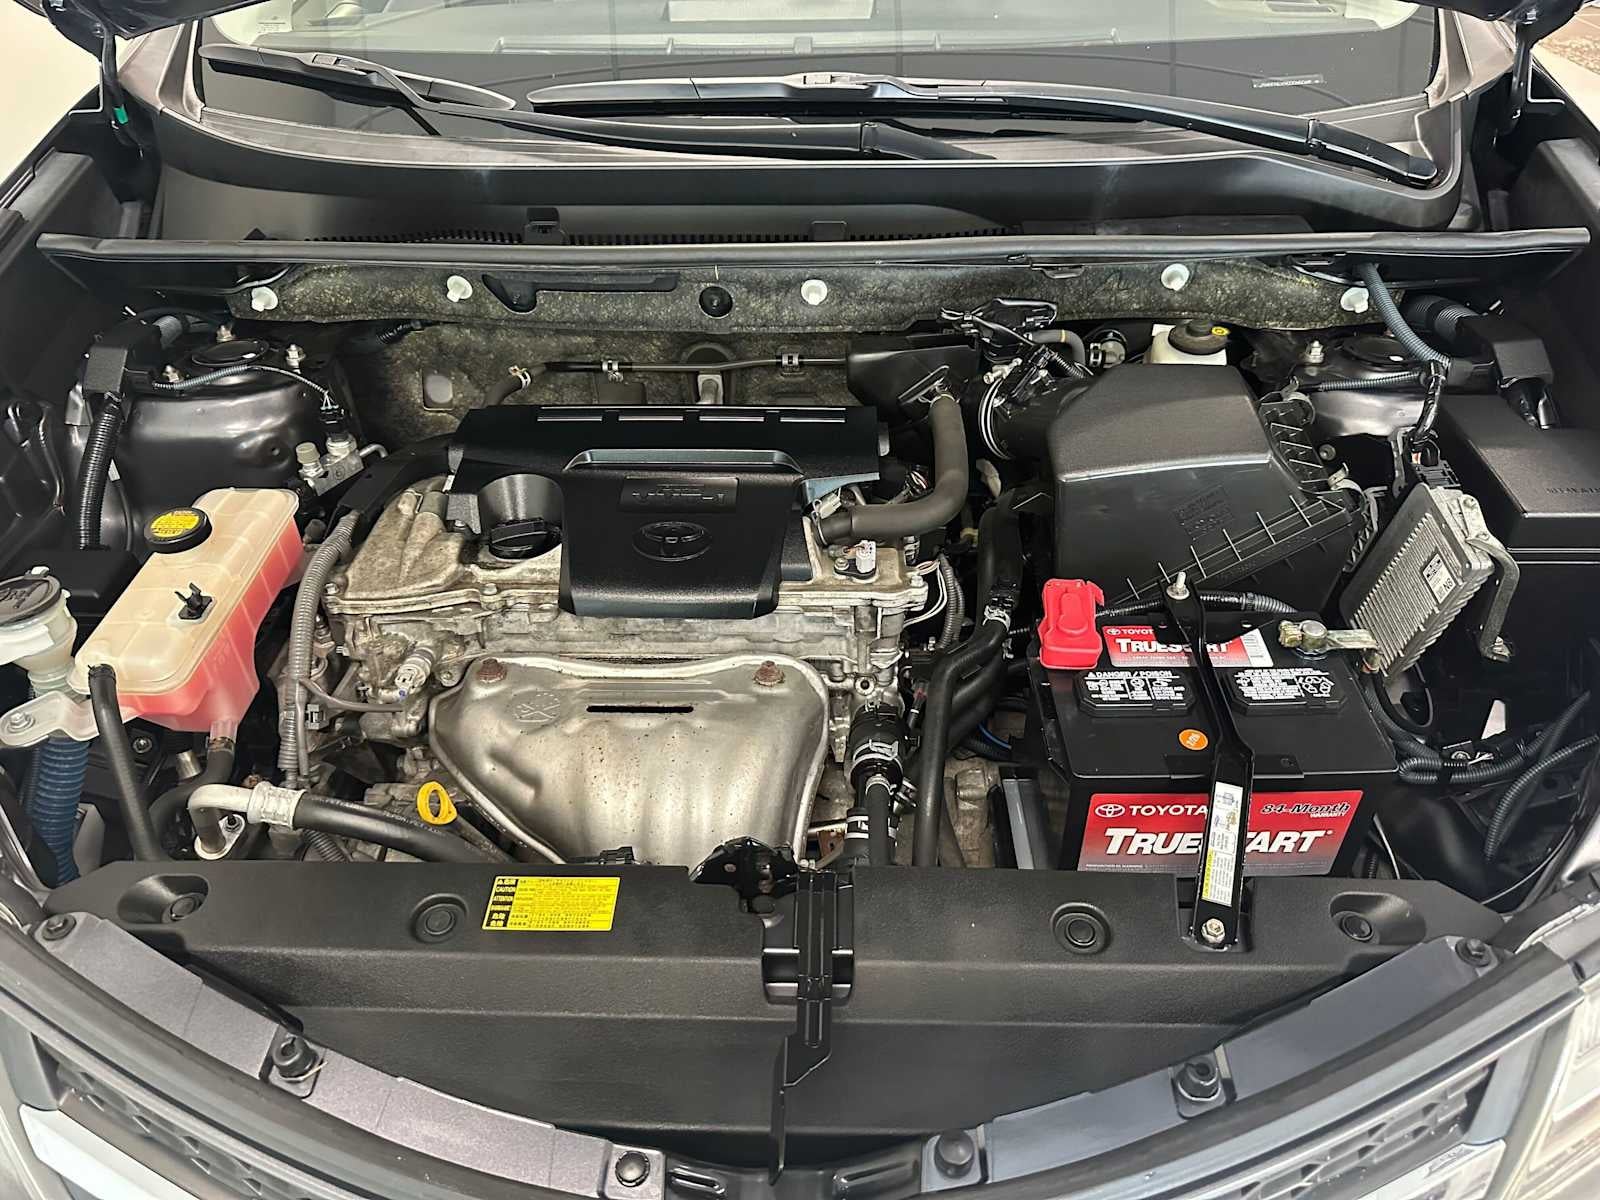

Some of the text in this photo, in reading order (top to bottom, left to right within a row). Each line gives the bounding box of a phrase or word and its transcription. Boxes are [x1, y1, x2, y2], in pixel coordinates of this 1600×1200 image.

[1095, 671, 1132, 679] DANGER
[1139, 670, 1173, 678] POISON
[1129, 804, 1208, 816] TOYOTA
[1261, 801, 1351, 815] 84-Month
[1104, 827, 1326, 855] TRUEART
